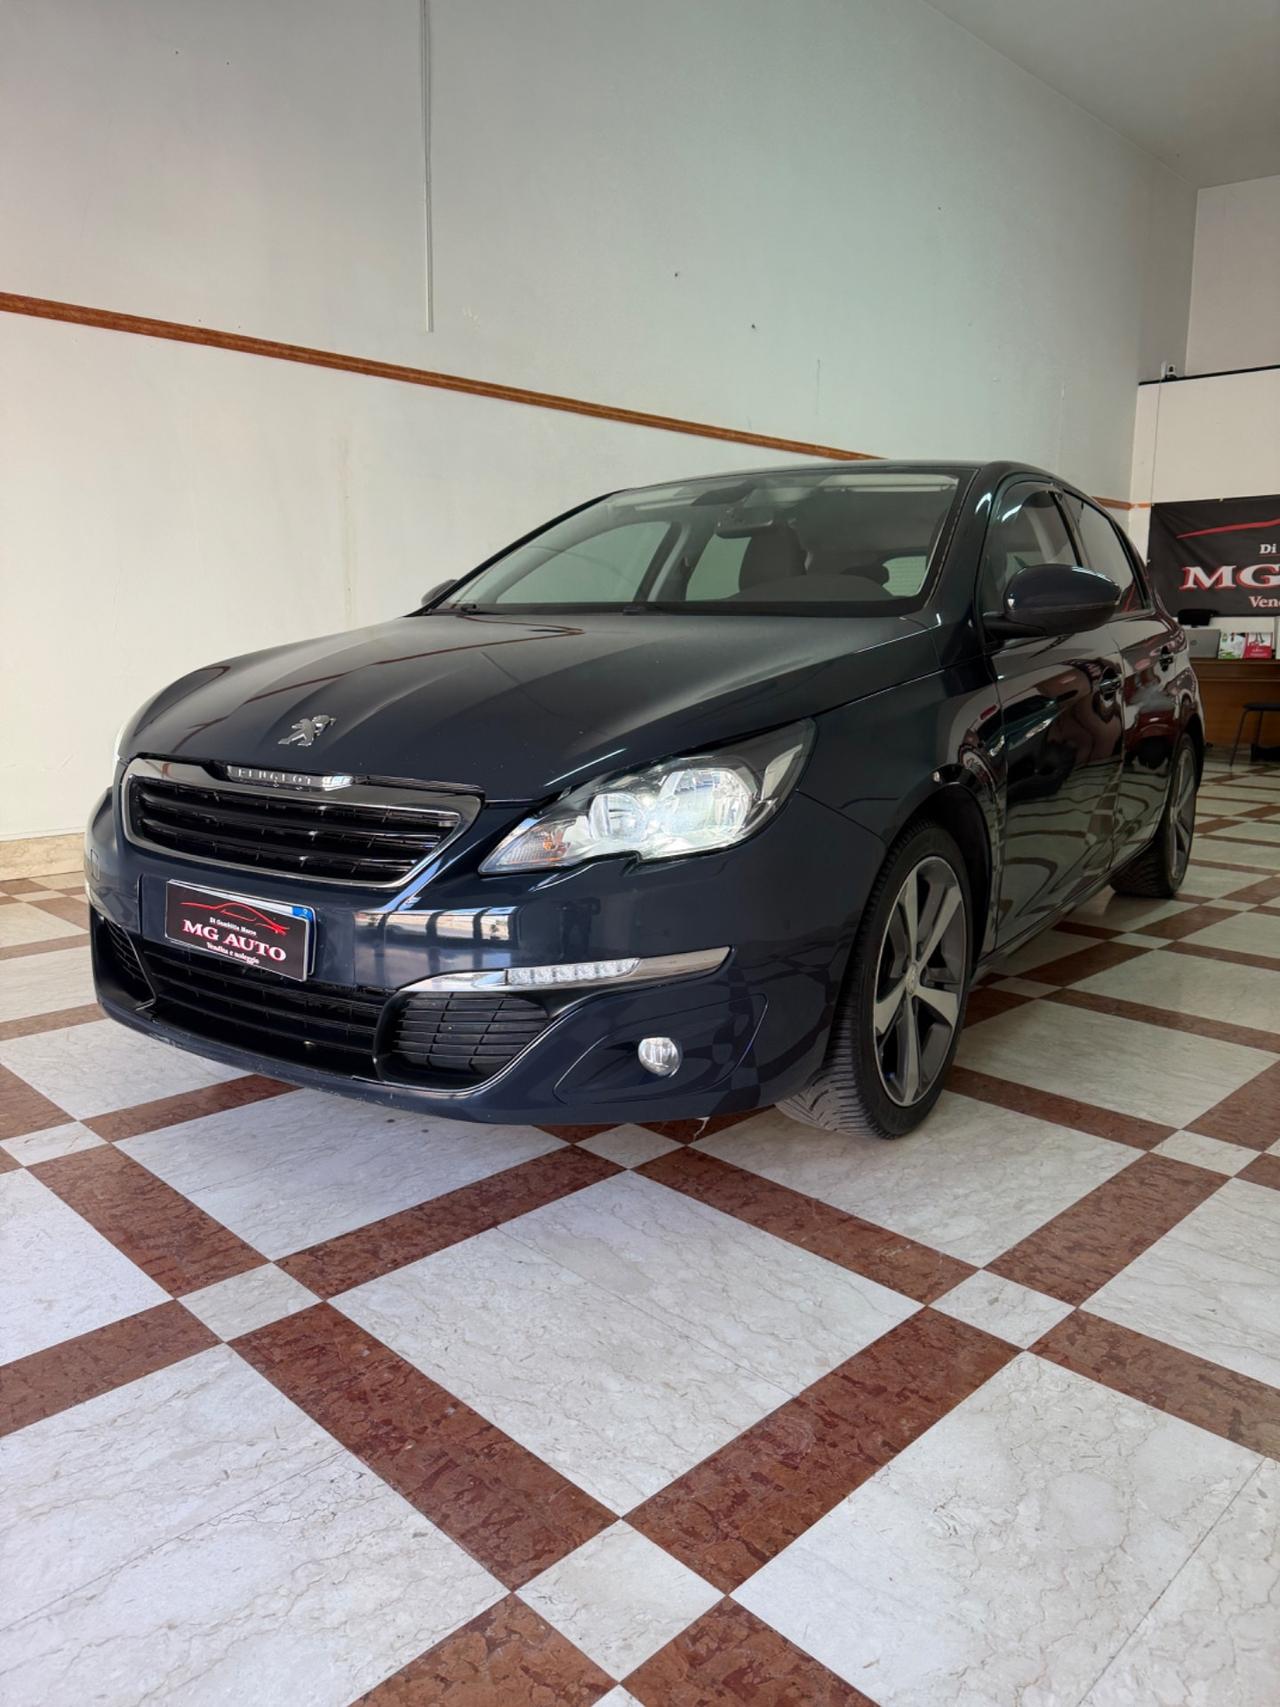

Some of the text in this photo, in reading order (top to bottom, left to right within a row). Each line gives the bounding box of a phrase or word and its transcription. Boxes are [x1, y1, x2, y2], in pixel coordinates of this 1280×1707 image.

[1259, 543, 1277, 554] Di
[1179, 563, 1280, 592] MG
[183, 919, 287, 962] MG AUTO
